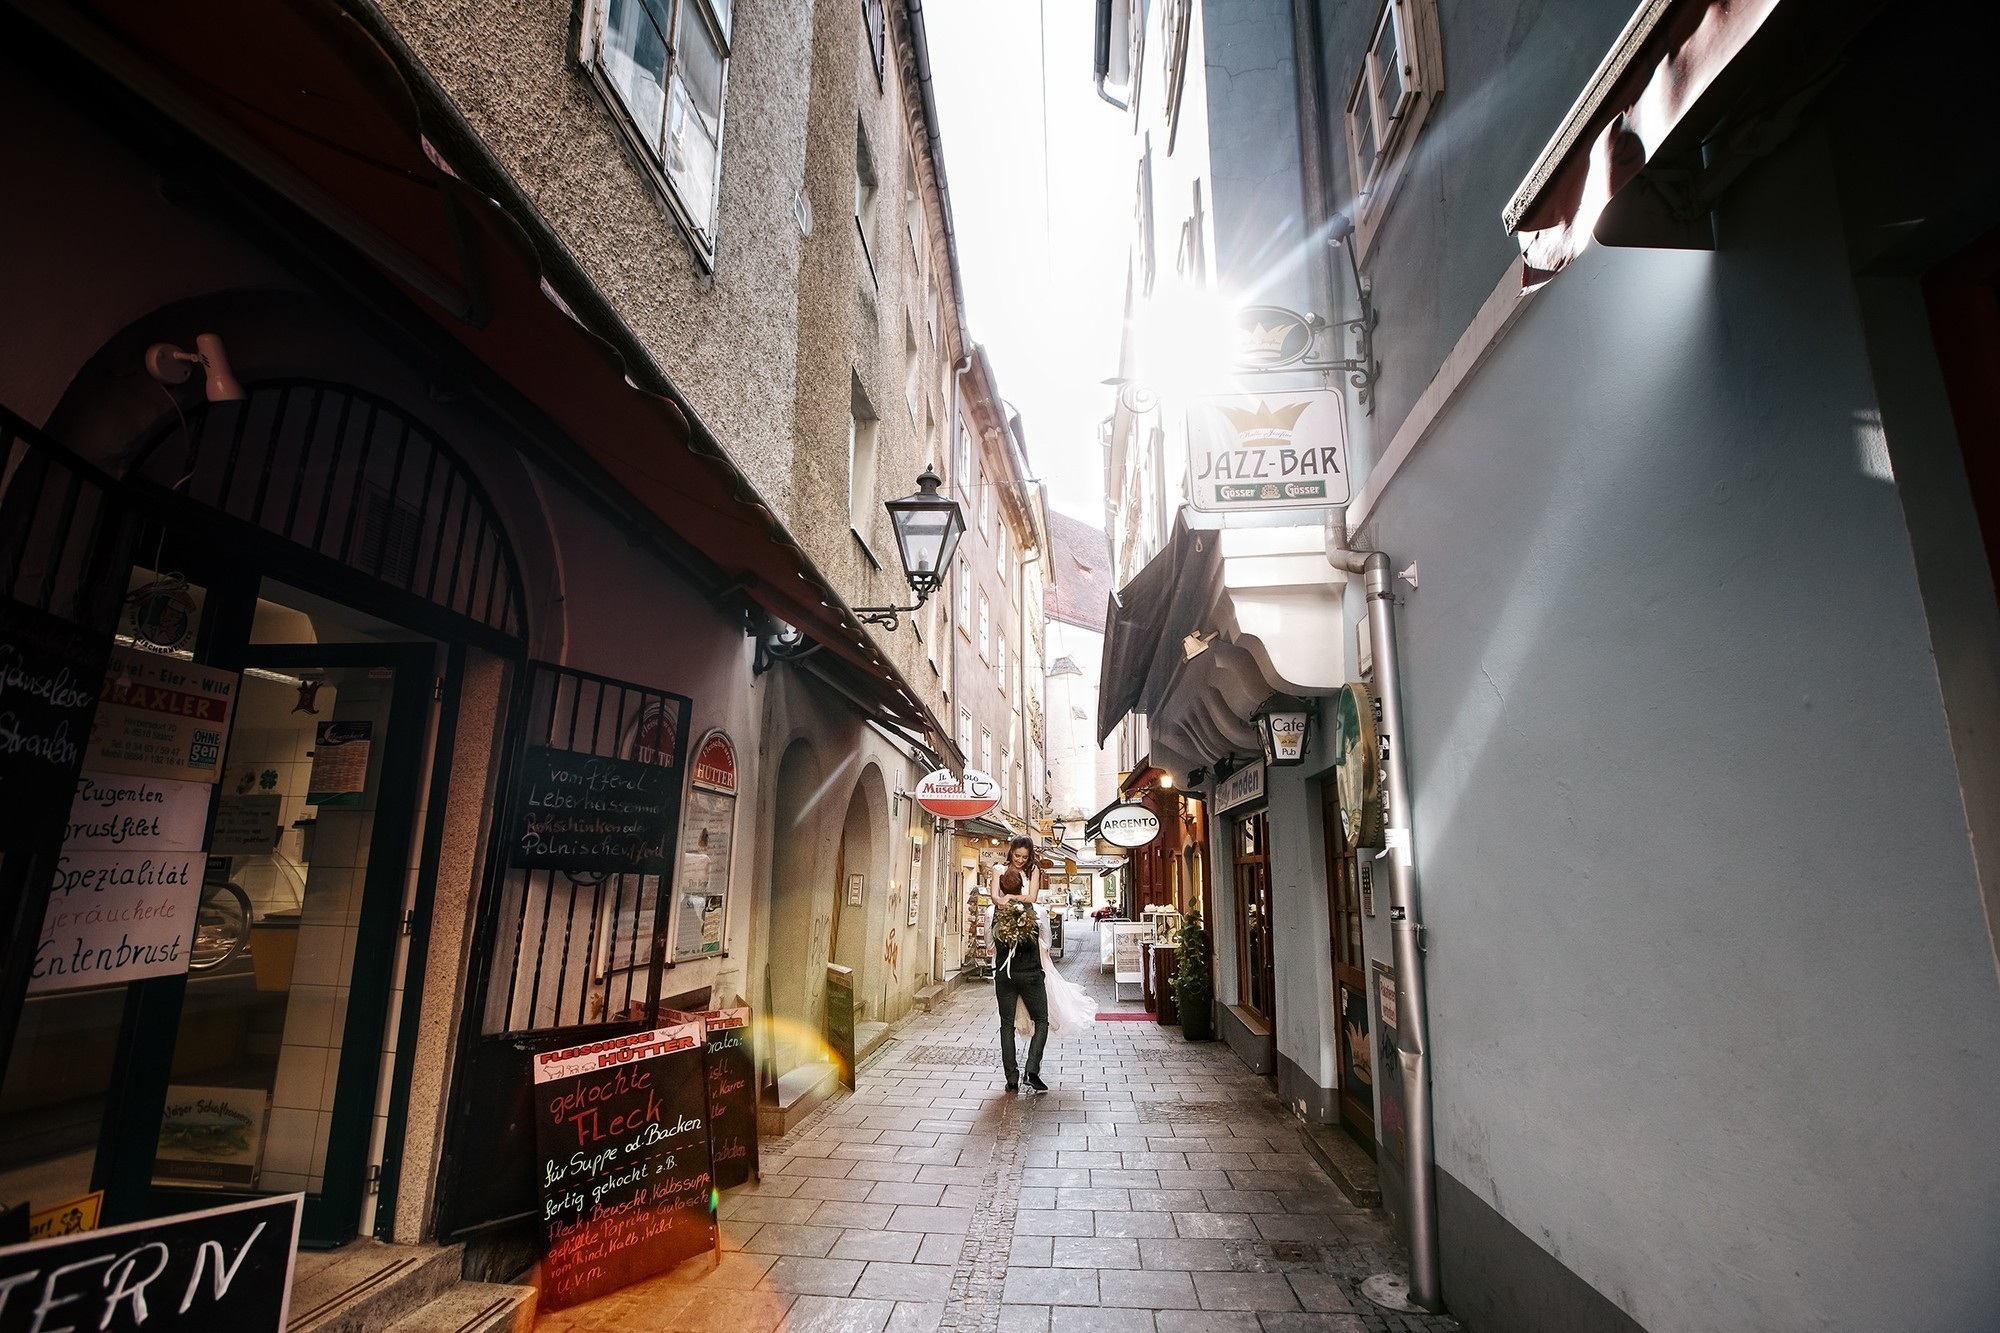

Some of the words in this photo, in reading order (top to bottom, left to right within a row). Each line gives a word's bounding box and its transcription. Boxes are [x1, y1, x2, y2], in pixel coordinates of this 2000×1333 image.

[1198, 447, 1340, 480] JAZZ-BAR
[1220, 485, 1256, 500] Gösser
[1284, 483, 1320, 498] Gösser
[161, 669, 186, 686] Eier
[202, 679, 230, 695] Wild
[194, 730, 219, 744] OHNE
[1272, 718, 1305, 732] Cafe
[190, 742, 217, 760] gen
[1282, 748, 1296, 756] Pub
[697, 763, 733, 787] HÜTTER
[1104, 817, 1157, 829] ARGENTO
[707, 1017, 743, 1030] TTER
[540, 1032, 655, 1065] FLEISCHEREI
[599, 1036, 696, 1068] HÜTTER
[550, 1065, 652, 1124] gekochte
[543, 1157, 568, 1188] für
[570, 1147, 618, 1177] Suppe
[644, 1114, 702, 1146] Backen
[543, 1192, 584, 1221] fertig
[592, 1167, 649, 1204] gekocht
